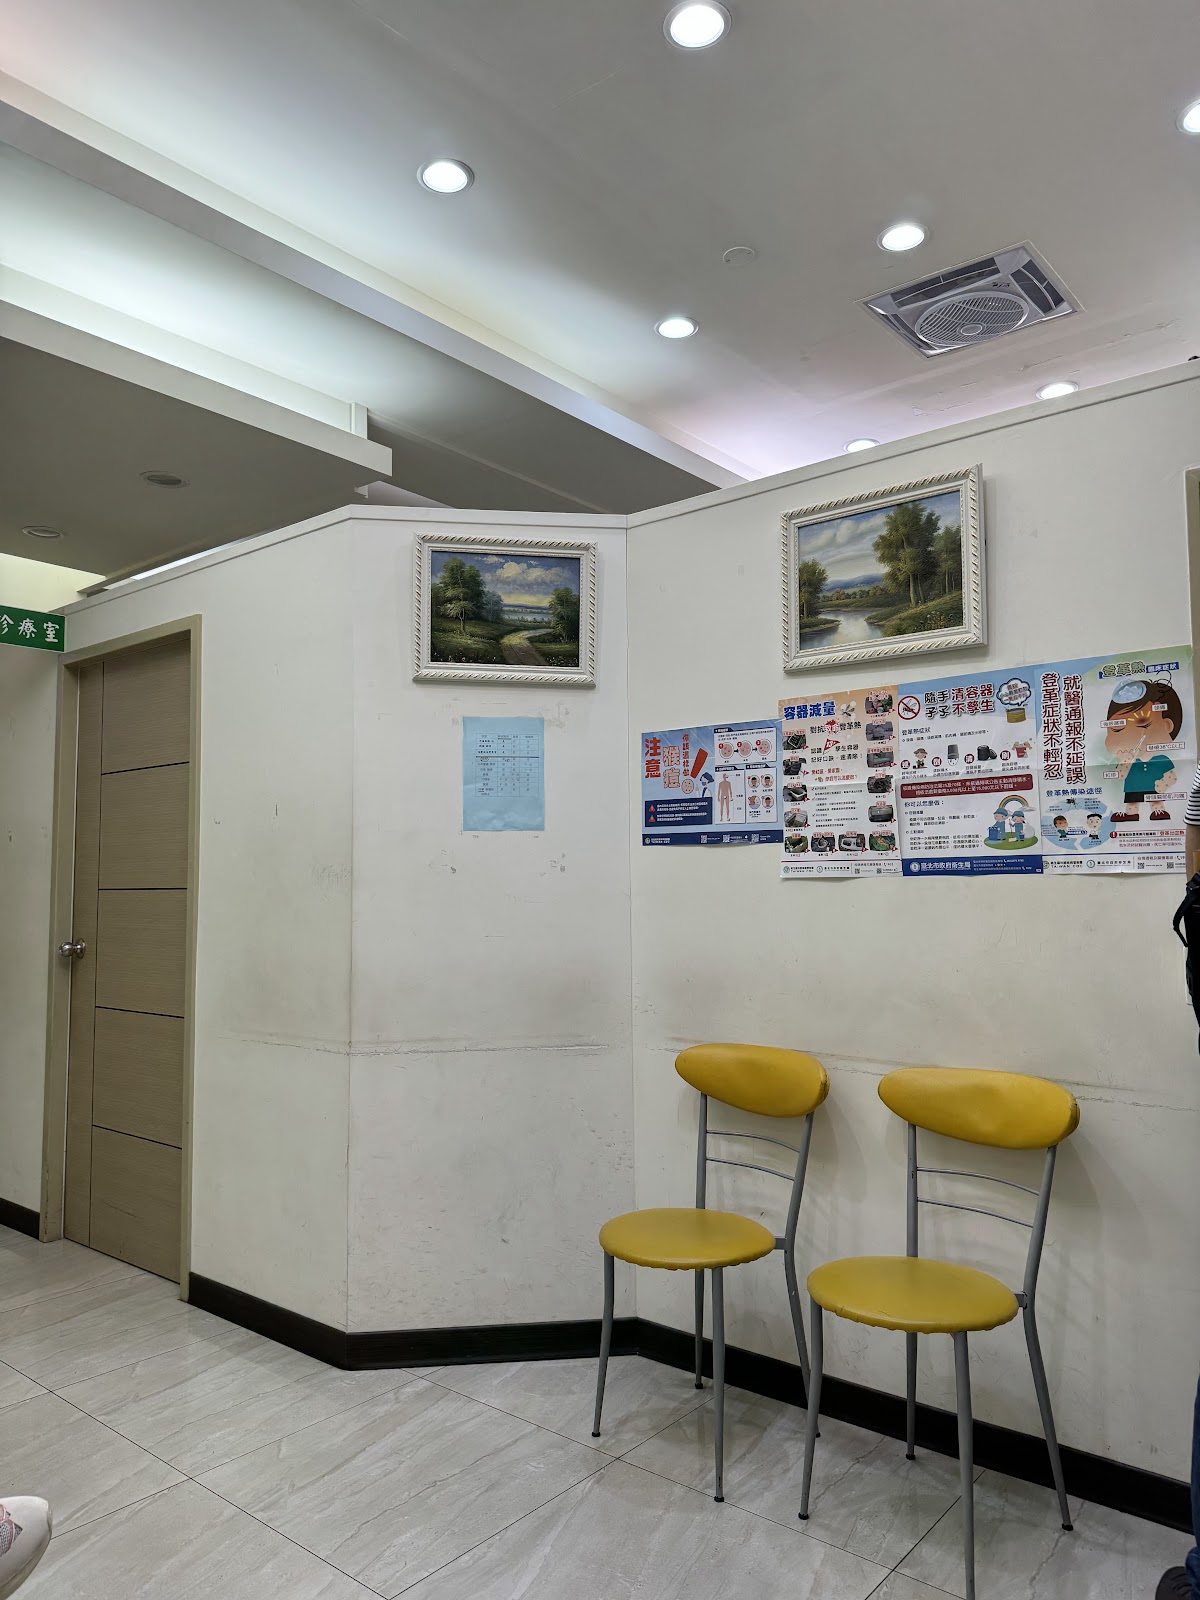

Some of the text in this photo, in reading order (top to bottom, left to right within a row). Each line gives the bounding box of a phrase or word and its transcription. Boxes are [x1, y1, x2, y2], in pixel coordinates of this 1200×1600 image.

[783, 701, 836, 720] 容器減量
[924, 683, 993, 704] 隨手清容器
[1041, 672, 1062, 779] 登革症狀不輕忽
[1063, 675, 1084, 783] 就醫通報不延誤
[645, 737, 661, 779] 注意
[662, 746, 681, 789] 猴痘
